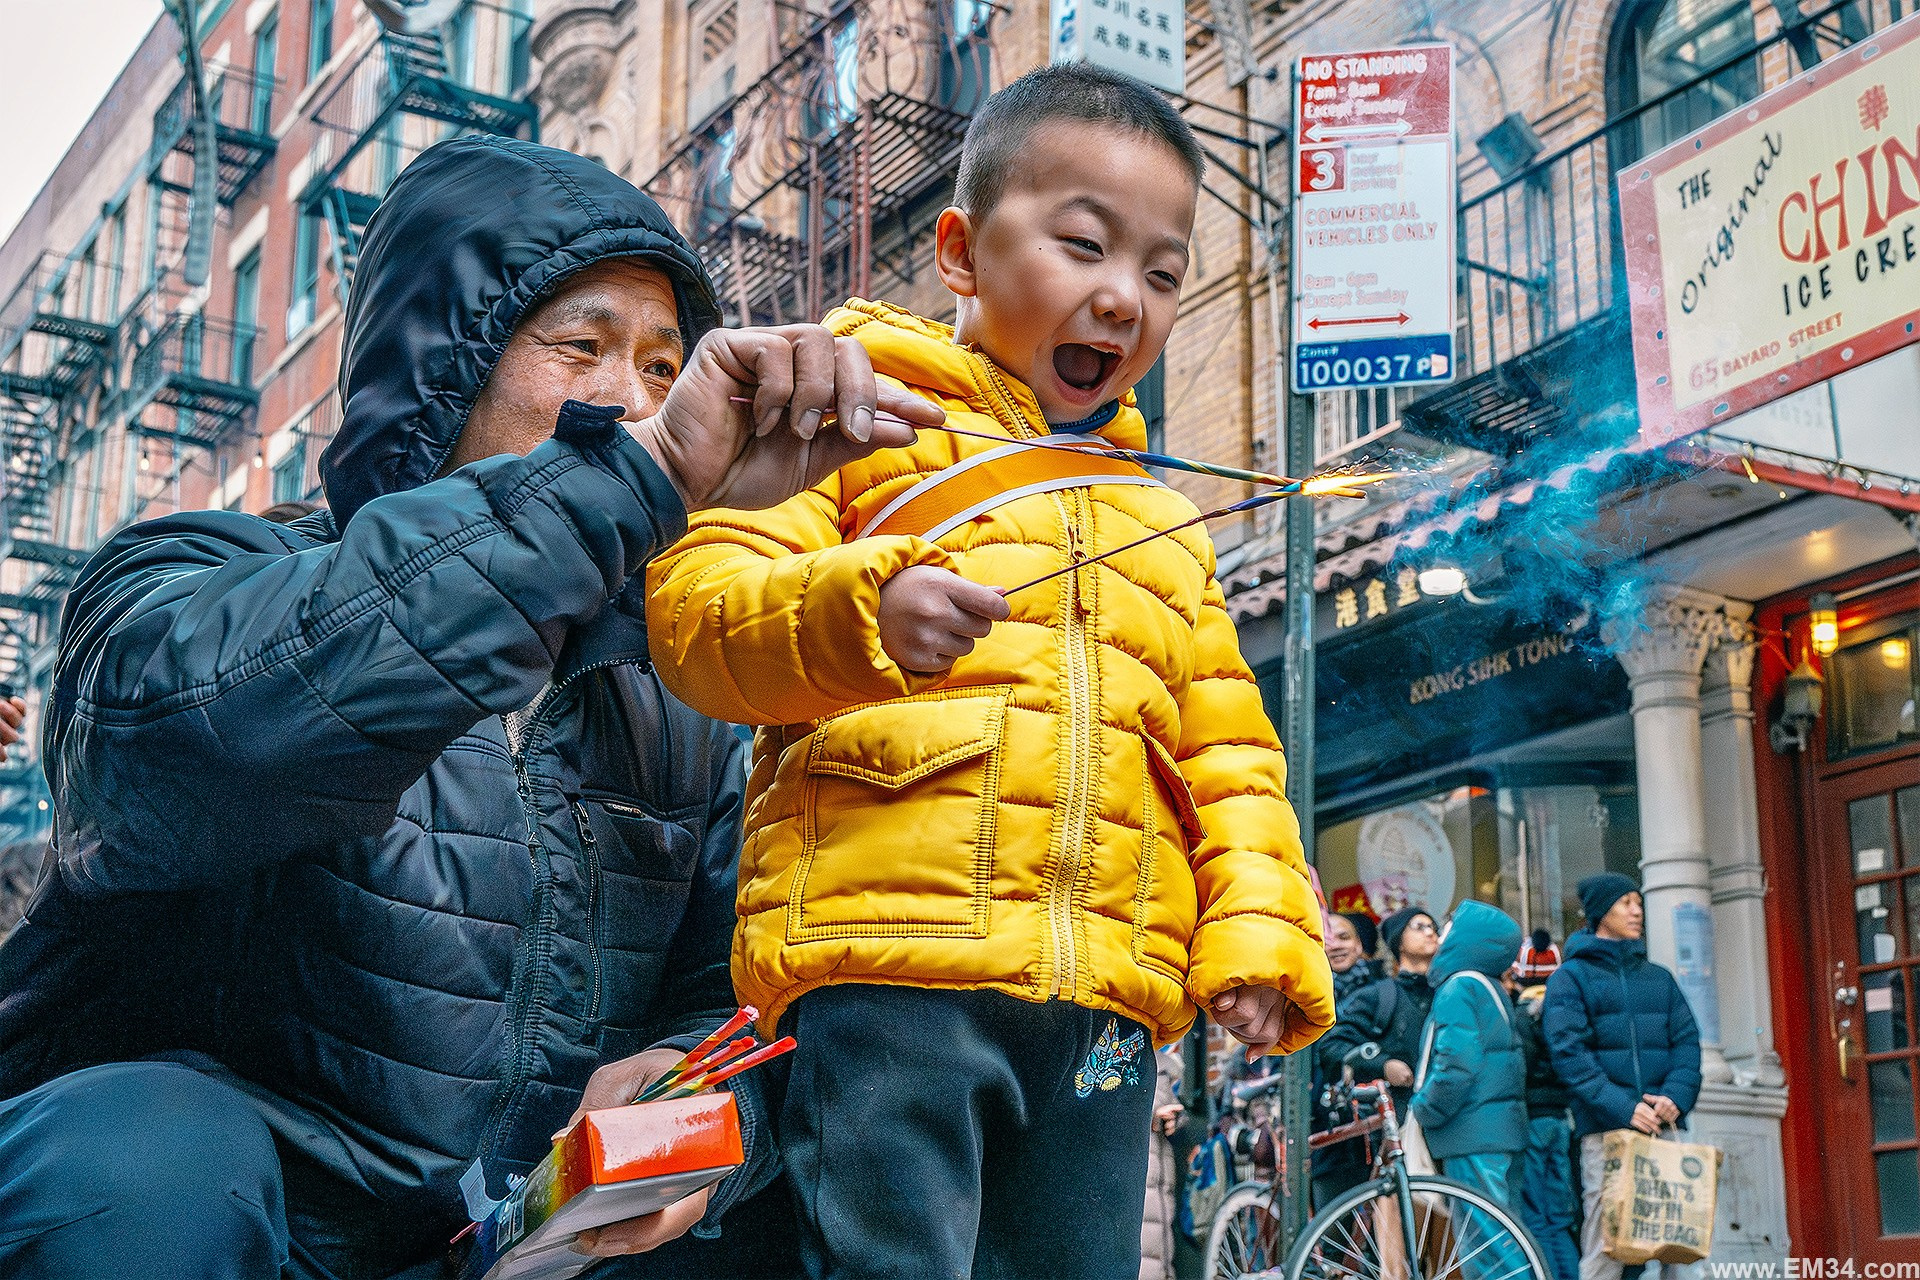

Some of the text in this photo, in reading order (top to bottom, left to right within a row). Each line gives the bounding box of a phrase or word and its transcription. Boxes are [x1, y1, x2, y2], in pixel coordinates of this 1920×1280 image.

[1305, 53, 1427, 80] NO STANDING
[1306, 84, 1337, 100] 7am
[1304, 98, 1407, 119] Except Sunday
[1310, 151, 1335, 190] 3
[1678, 168, 1711, 210] THE
[1305, 202, 1420, 226] COMMERCIAL
[1681, 130, 1782, 314] Original
[1305, 222, 1437, 248] VEHICLES ONLY
[1783, 223, 1917, 316] ICE CRE
[1304, 289, 1408, 309] Except Sunday
[1689, 311, 1842, 391] 65 BAYARD STREET
[1300, 354, 1411, 386] 100037
[1631, 1218, 1699, 1246] THE BAG
